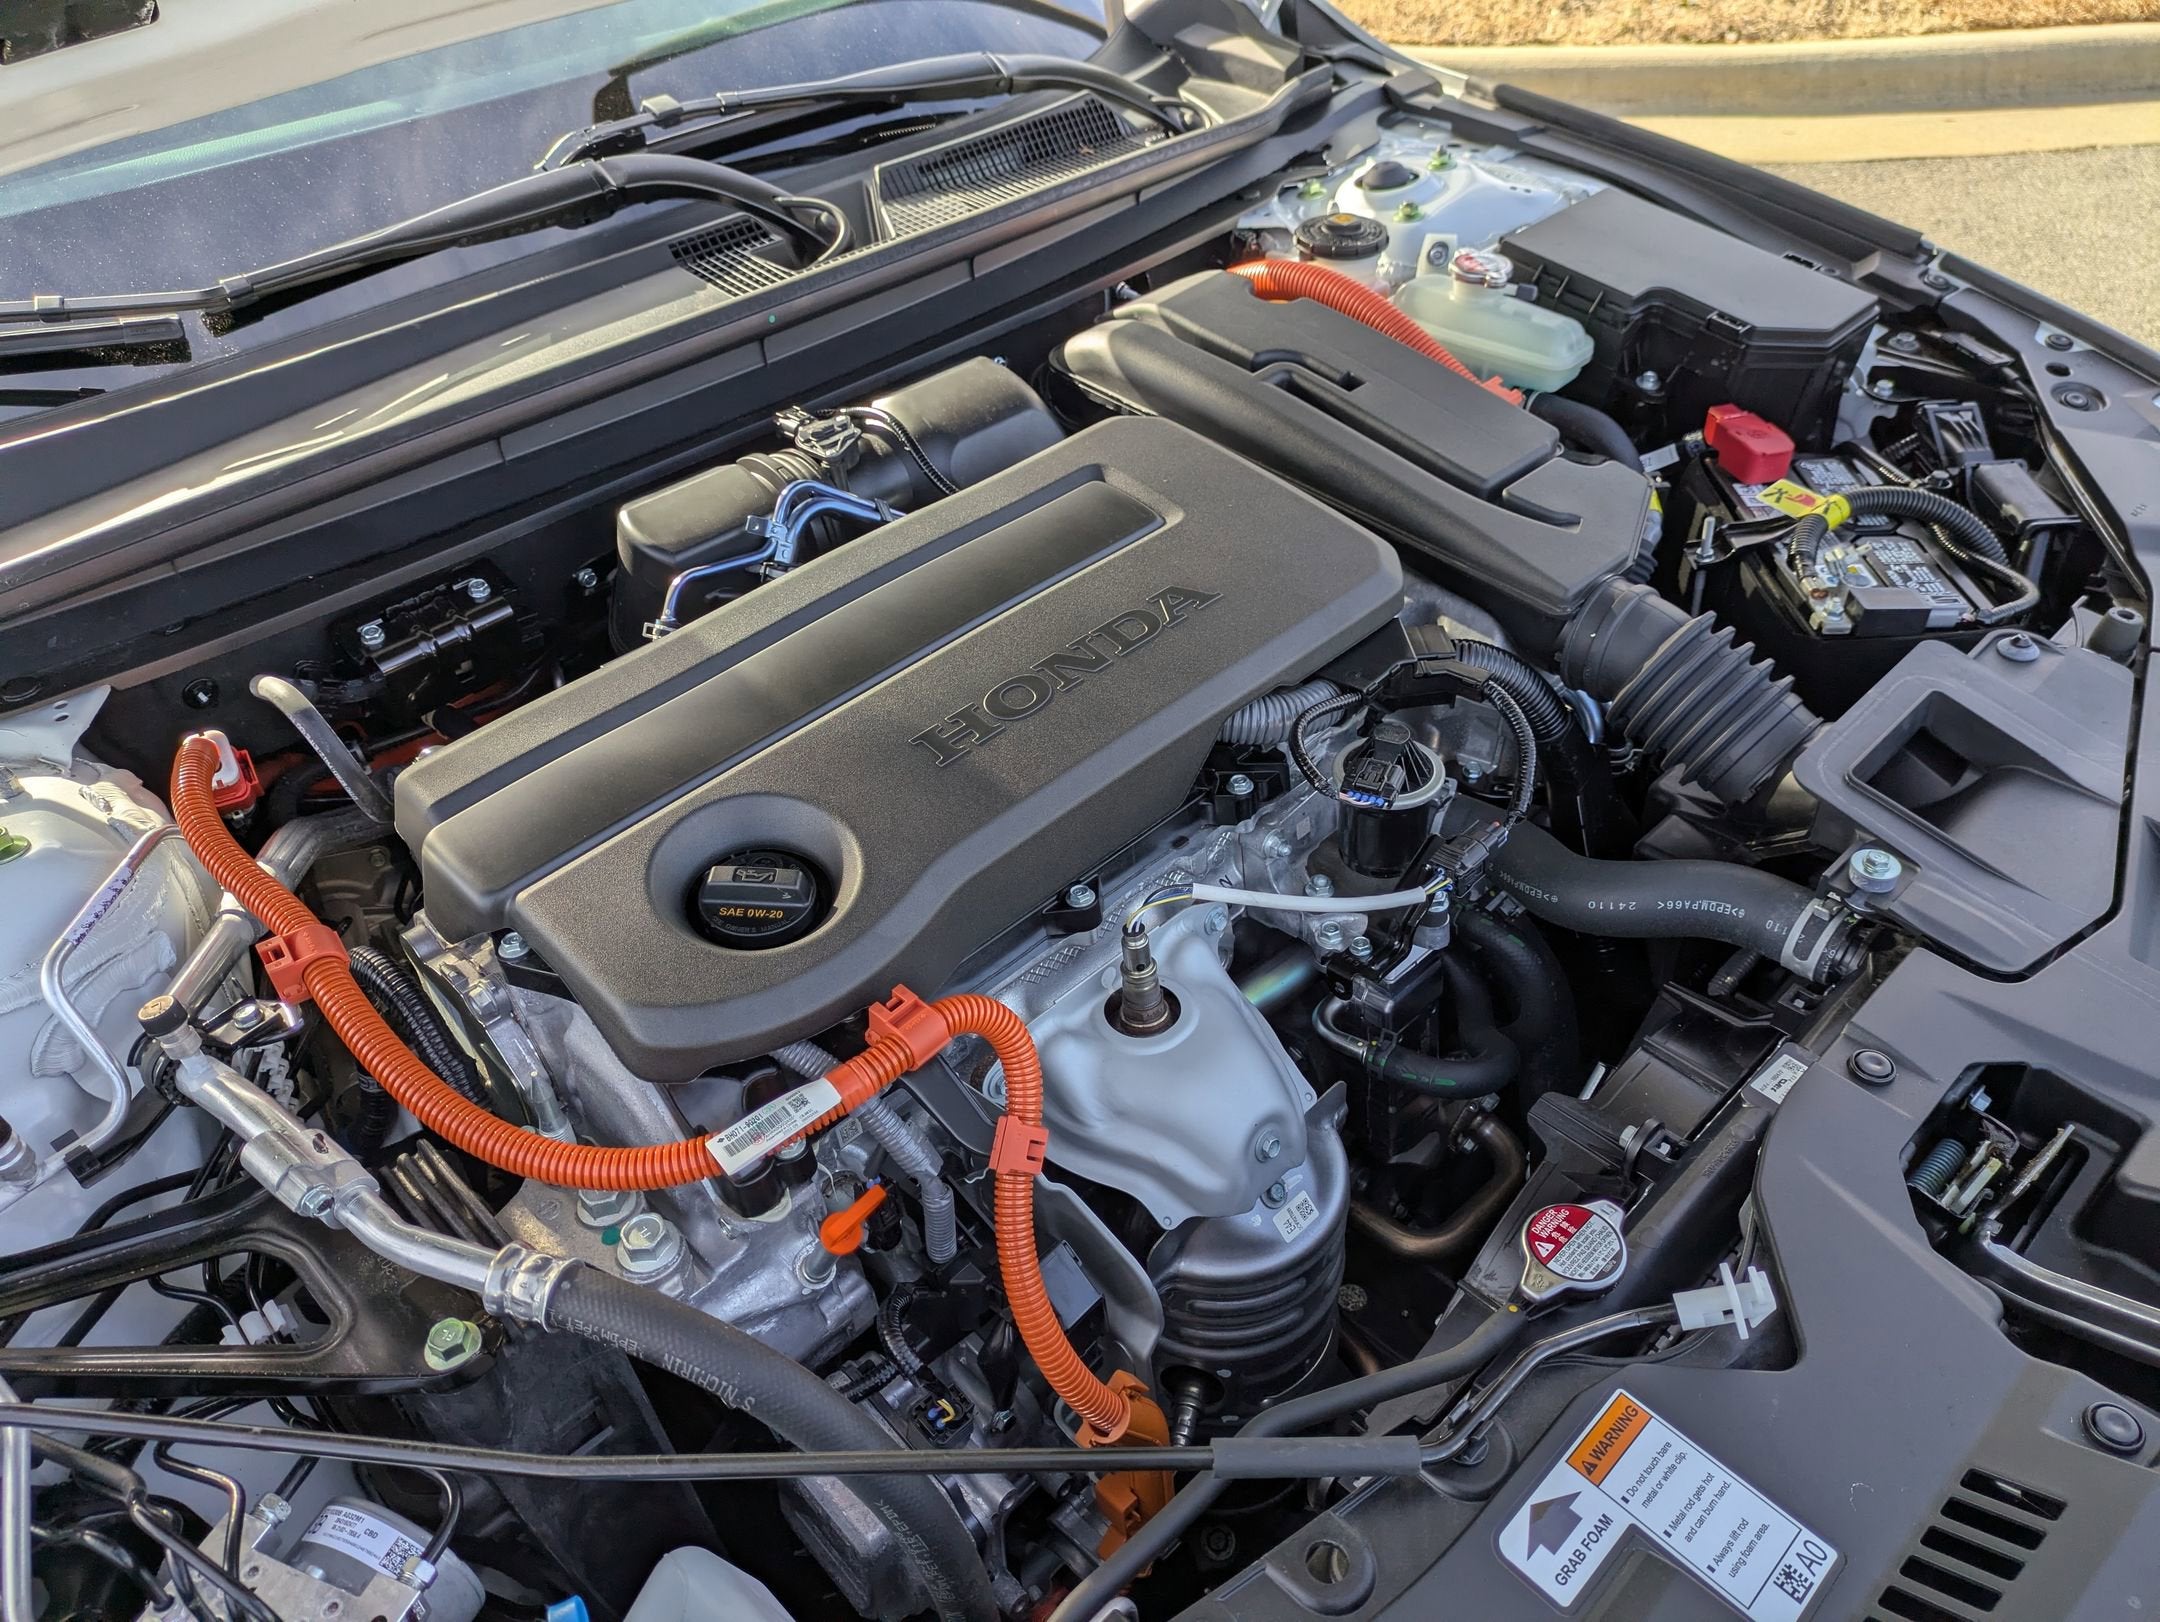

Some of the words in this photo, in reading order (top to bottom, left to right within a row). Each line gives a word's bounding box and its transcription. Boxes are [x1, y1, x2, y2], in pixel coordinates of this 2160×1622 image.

[908, 585, 1224, 767] HONDA
[719, 907, 744, 917] SAE
[747, 908, 784, 919] 0W-20
[1588, 901, 1637, 911] 24110
[1531, 1208, 1558, 1234] DANGER
[1539, 1208, 1570, 1239] WARNUNG
[1589, 1405, 1639, 1461] WARNING
[1626, 1485, 1639, 1498] Do
[1635, 1470, 1647, 1485] not
[1643, 1456, 1661, 1476] touch
[1658, 1441, 1672, 1460] bare
[1642, 1488, 1658, 1509] metal
[1657, 1477, 1664, 1490] or
[1662, 1463, 1677, 1483] white
[1674, 1451, 1688, 1468] clip.
[1669, 1510, 1686, 1531] Metal
[1684, 1497, 1695, 1512] rod
[1693, 1486, 1705, 1503] gets
[1703, 1472, 1715, 1490] hot
[1685, 1526, 1698, 1543] and
[1695, 1513, 1707, 1529] can
[1704, 1497, 1718, 1516] burn
[1715, 1480, 1732, 1502] hand.
[364, 1528, 378, 1539] CBD
[1555, 1548, 1586, 1586] GRAB
[1584, 1513, 1614, 1552] FOAM
[1712, 1540, 1732, 1566] Always
[1729, 1527, 1740, 1546] lift
[1737, 1518, 1749, 1533] rod
[1729, 1556, 1747, 1578] using
[1743, 1538, 1758, 1559] foam
[1754, 1523, 1770, 1543] area.
